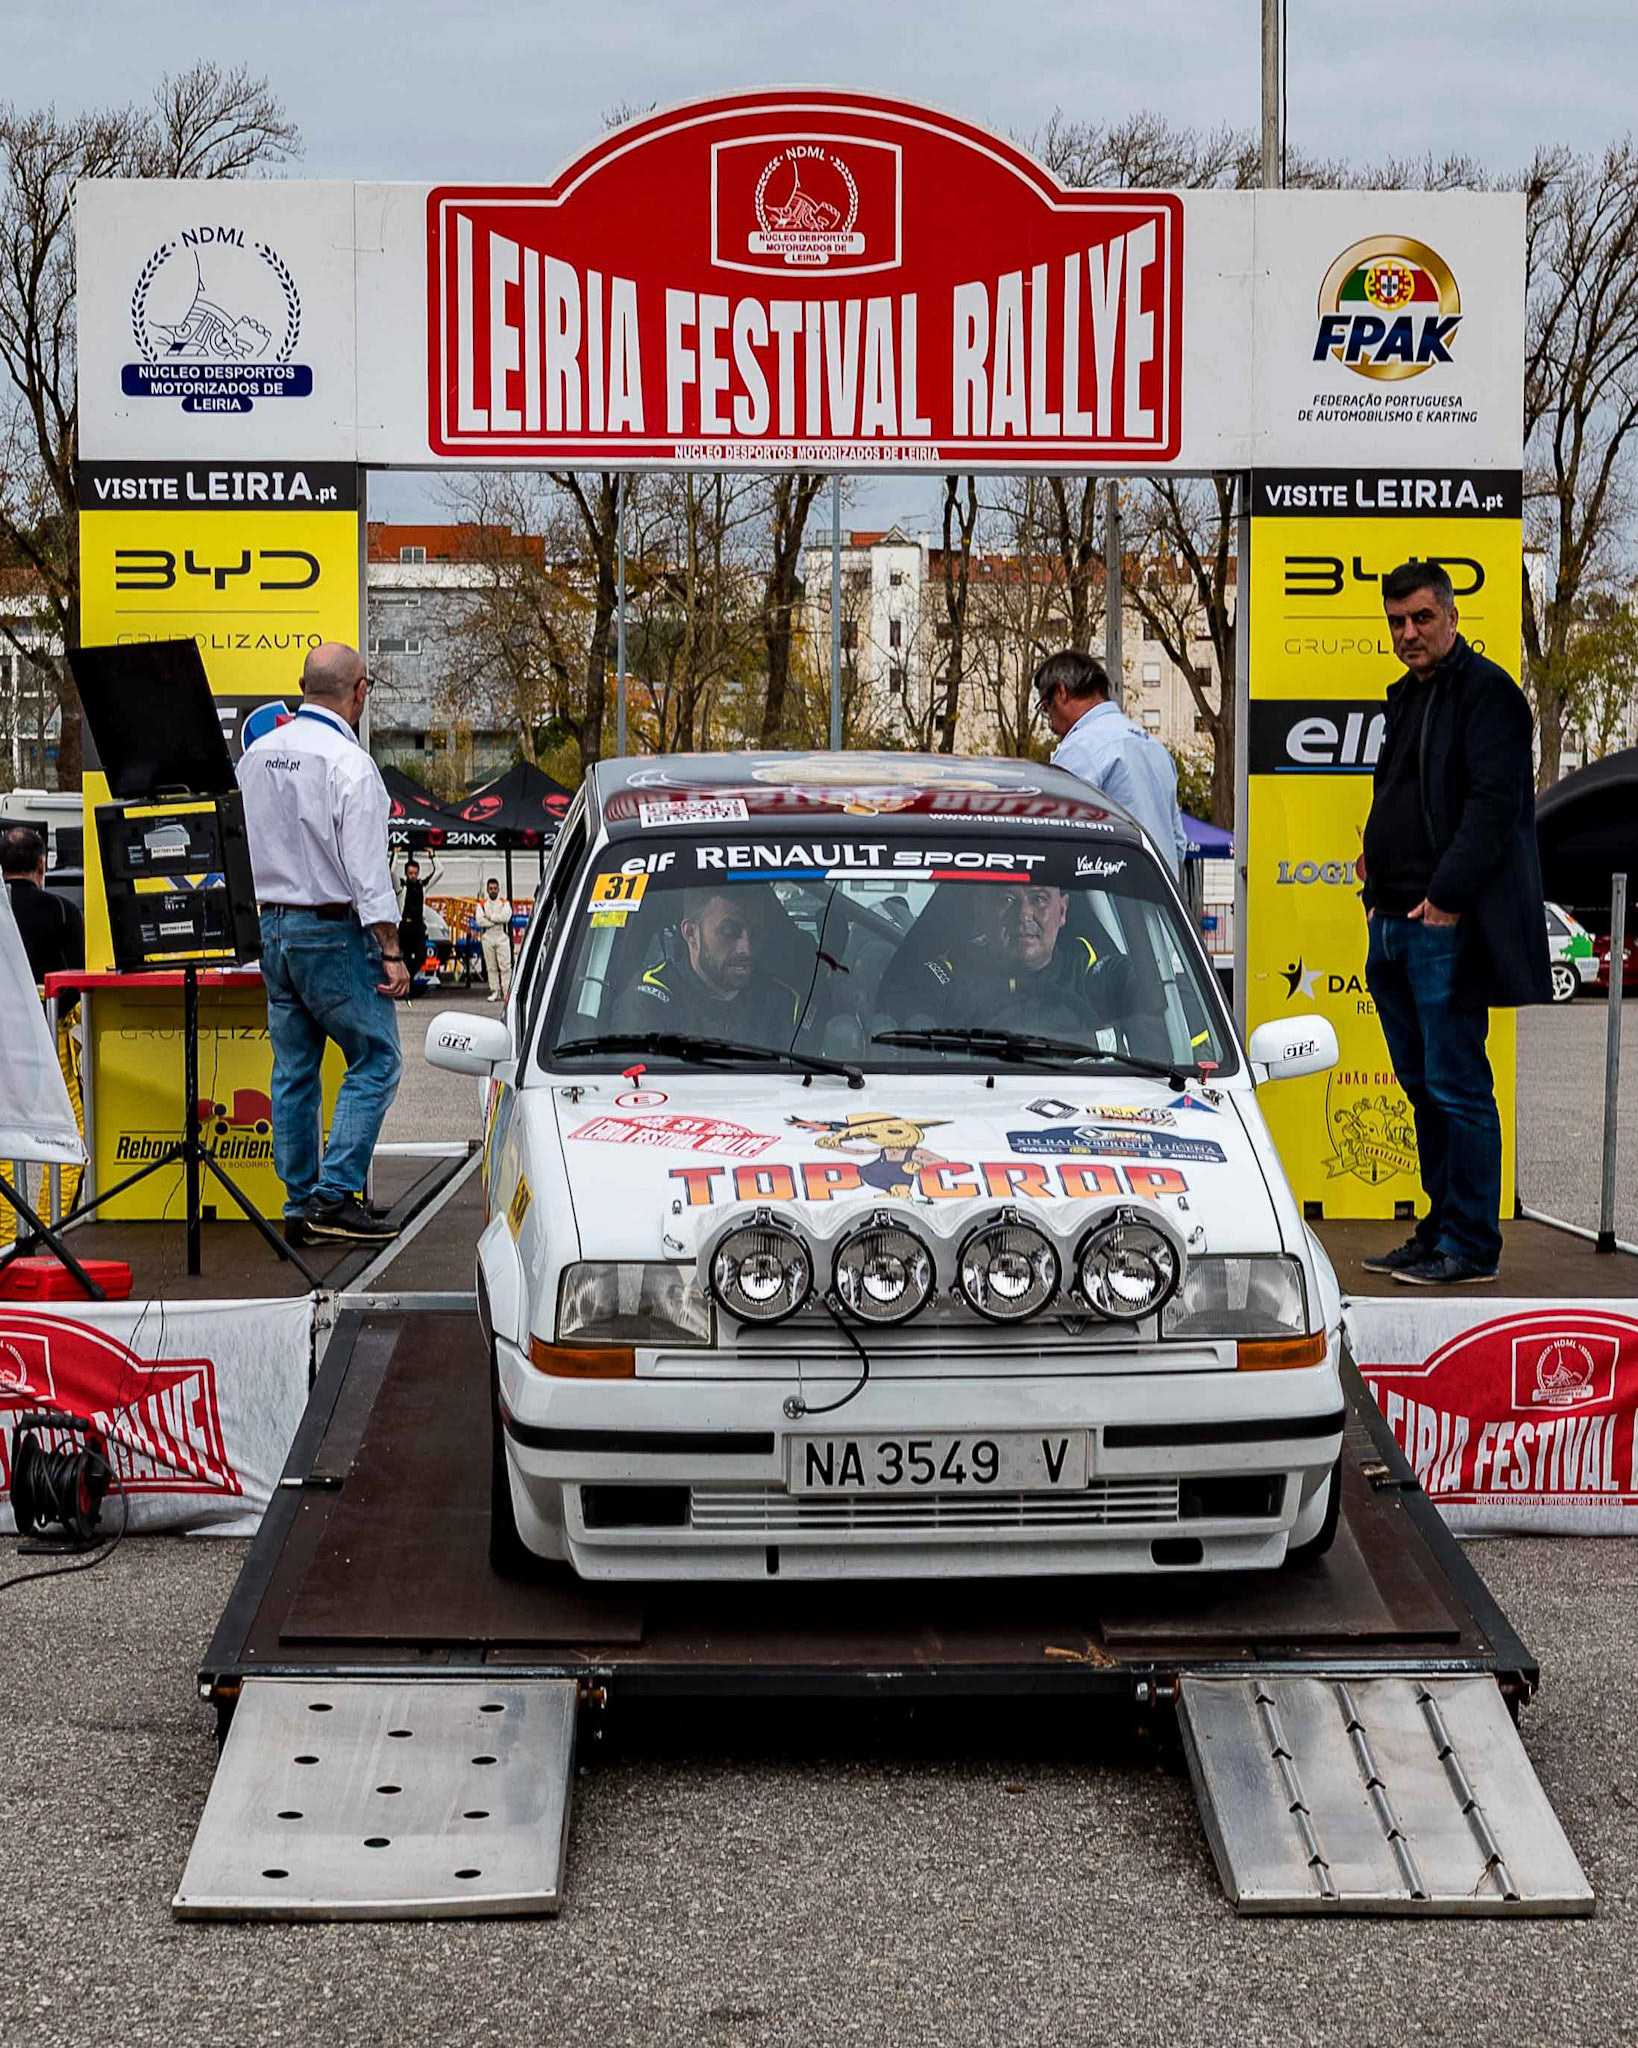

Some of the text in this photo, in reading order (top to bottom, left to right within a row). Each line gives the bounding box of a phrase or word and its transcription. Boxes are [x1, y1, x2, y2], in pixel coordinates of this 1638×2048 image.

[786, 146, 825, 160] NDML
[181, 226, 246, 249] NDML
[799, 234, 854, 243] DESPORTOS
[766, 243, 847, 252] MOTORIZADOS DE
[792, 254, 821, 262] LEIRIA
[458, 212, 1157, 438] LEIRIA FESTIVAL RALLYE
[1312, 315, 1463, 363] FPAK
[204, 366, 295, 380] DESPORTOS
[150, 382, 284, 396] MOTORIZADOS DE
[193, 398, 241, 411] LEIRIA
[1313, 393, 1463, 409] FEDERAÇÃO PORTUGUESA
[1297, 410, 1478, 423] DE AUTOMOBILISMO E KARTING
[725, 445, 794, 460] DESPORTOS
[797, 446, 880, 461] MOTORIZADOS
[883, 447, 899, 461] DE
[901, 447, 940, 461] LEIRIA
[94, 472, 338, 503] VISITE LEIRIA.pt
[1265, 479, 1503, 512] VISITE LEIRIA.pt
[115, 550, 321, 590] BYD
[265, 757, 300, 773] ndml.pt
[446, 832, 497, 846] 24MX
[621, 851, 676, 875] elf
[696, 844, 888, 869] RENAULT
[892, 851, 1046, 870] SPORT
[604, 875, 638, 900] 31
[1328, 975, 1371, 994] DA
[1337, 1071, 1368, 1085] JOÃO
[668, 1162, 1191, 1206] TOP CROP
[1472, 1413, 1620, 1492] FESTIVAL
[805, 1438, 1070, 1487] NA 3549 V
